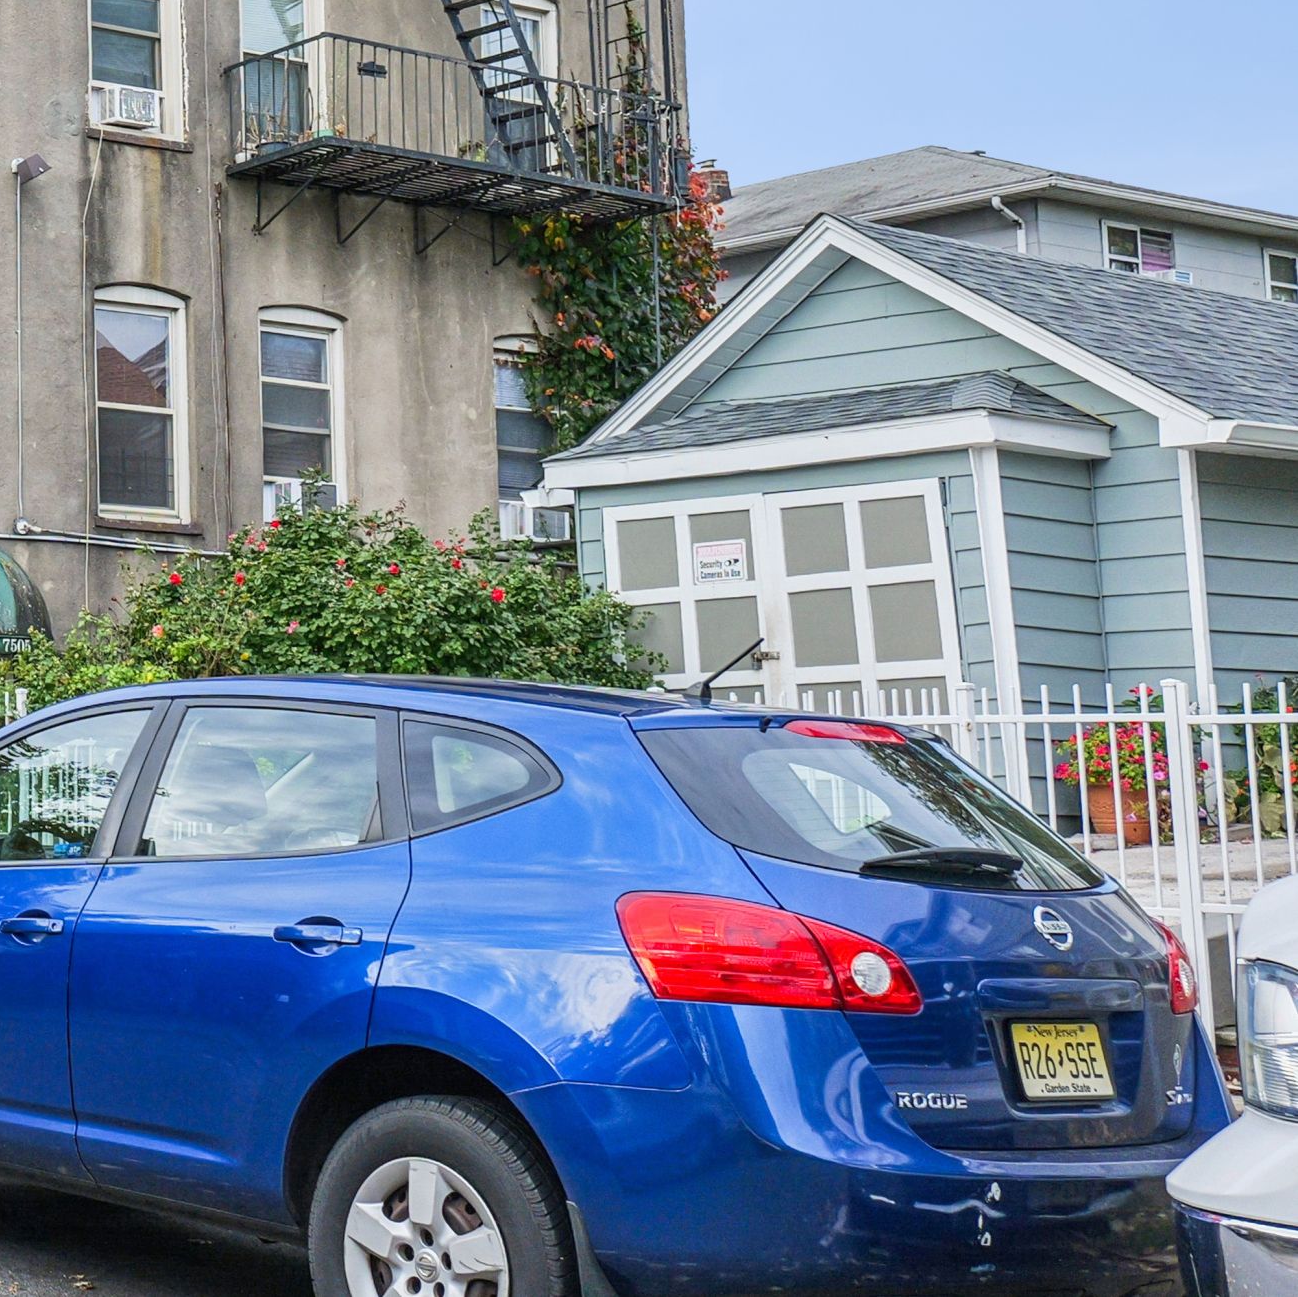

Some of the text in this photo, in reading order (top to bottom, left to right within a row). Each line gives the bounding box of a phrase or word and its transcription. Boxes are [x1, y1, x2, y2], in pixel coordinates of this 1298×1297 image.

[699, 559, 723, 570] Security
[700, 570, 723, 580] Cameras
[1032, 1025, 1079, 1040] New Jersey
[1044, 1082, 1092, 1094] Garden State
[896, 1091, 969, 1110] ROGUE
